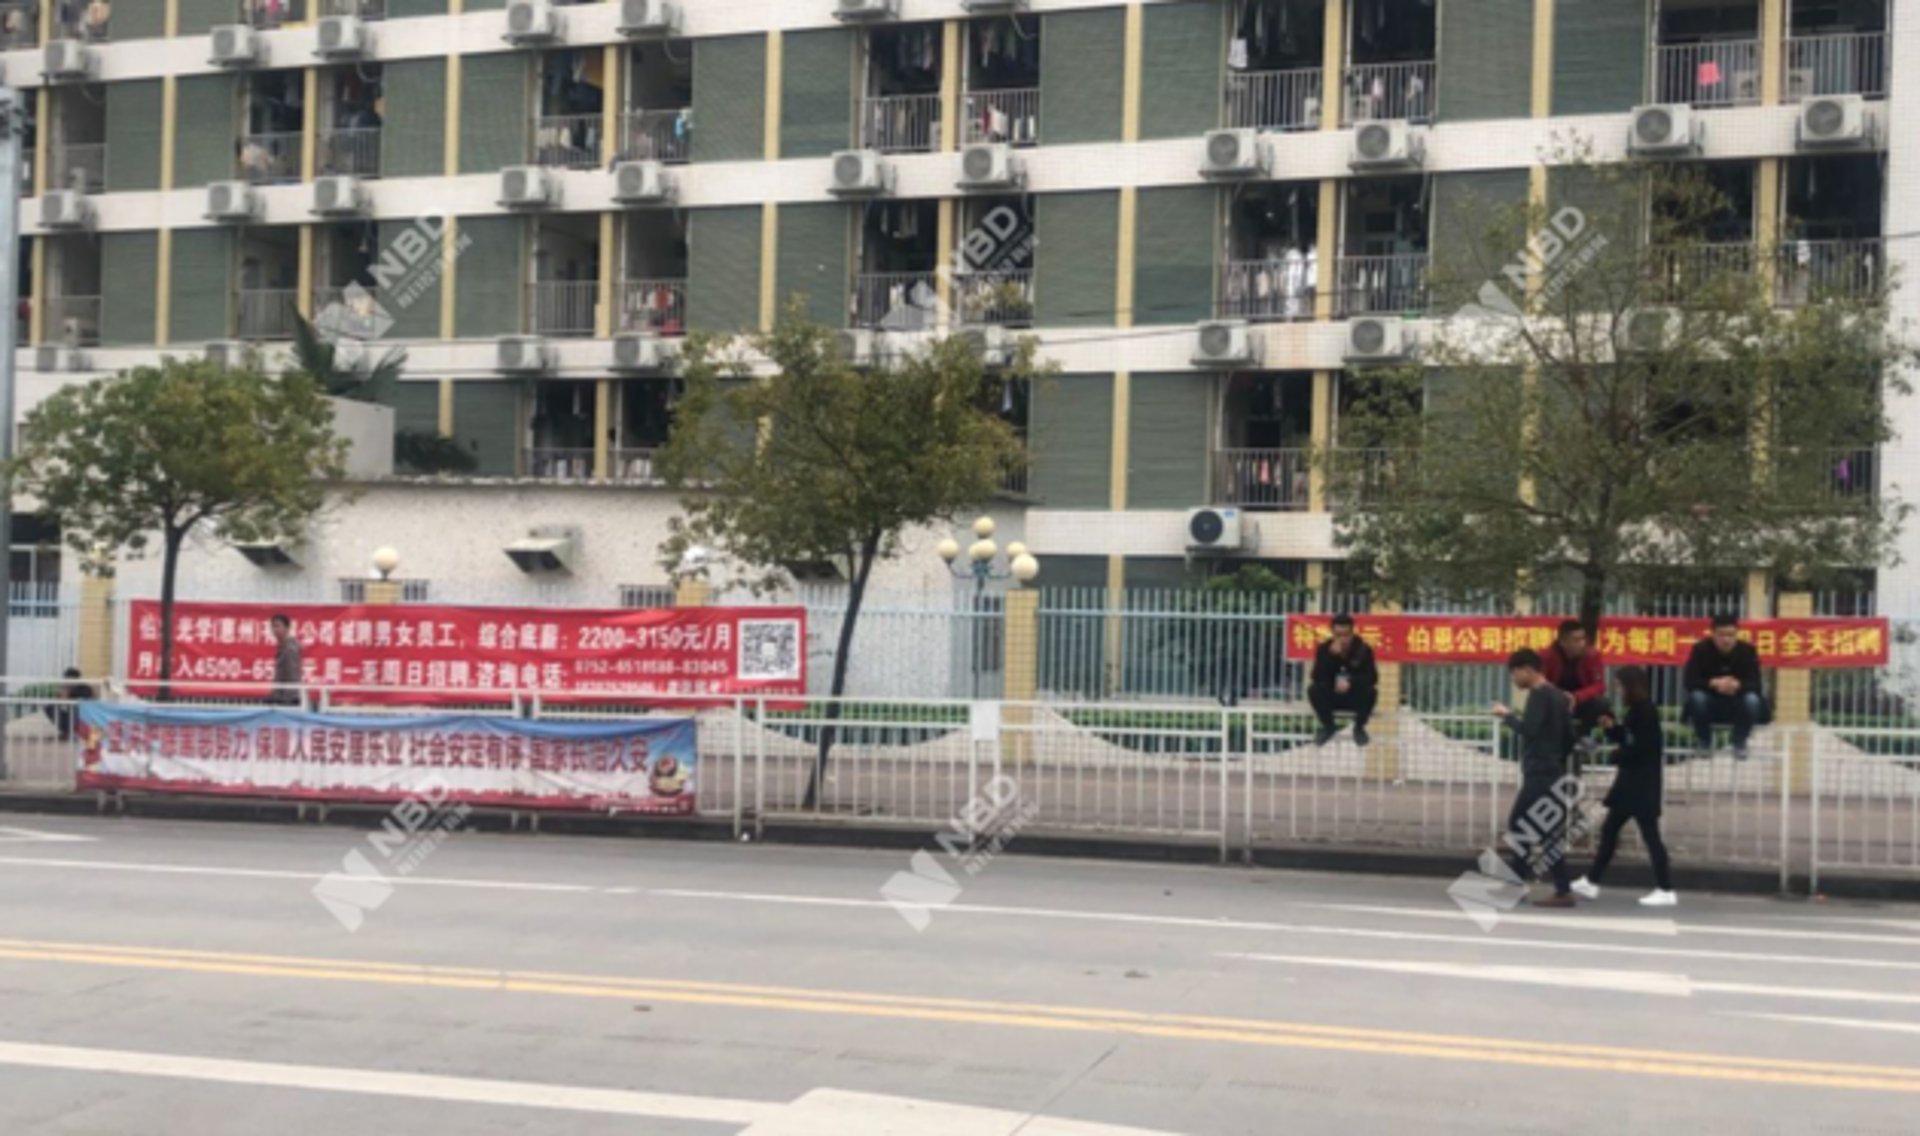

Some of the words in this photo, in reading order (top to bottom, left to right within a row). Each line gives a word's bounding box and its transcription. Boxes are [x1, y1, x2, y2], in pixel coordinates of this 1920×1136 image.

[255, 725, 404, 767] 保障人民安居乐业
[408, 731, 524, 771] 社会安定有序
[528, 735, 650, 774] 国家长治久安
